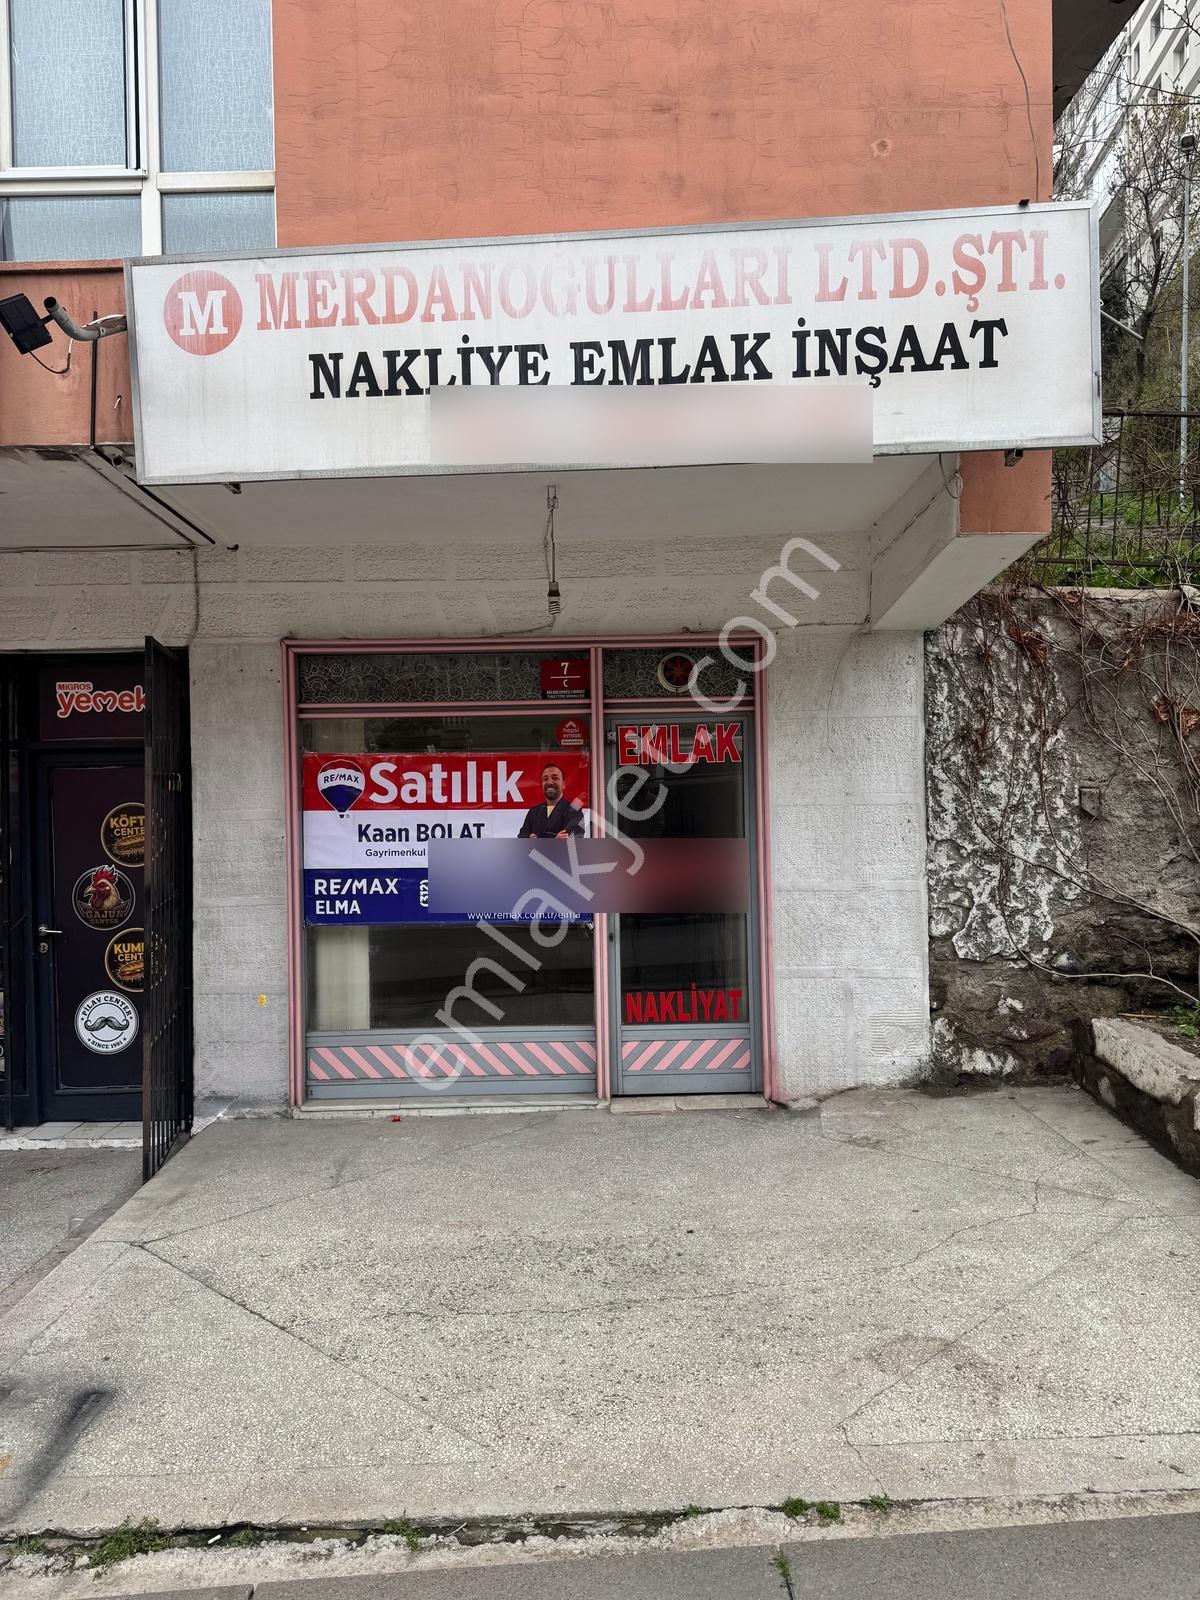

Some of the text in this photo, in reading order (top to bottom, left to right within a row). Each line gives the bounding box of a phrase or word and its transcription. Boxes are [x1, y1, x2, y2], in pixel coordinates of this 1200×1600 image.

[177, 290, 229, 337] M
[309, 317, 1008, 400] NAKLİYE EMLAK İNŞAAT
[560, 662, 570, 676] 7
[617, 723, 742, 765] EMLAK
[323, 774, 360, 784] RE/MAX
[369, 761, 525, 804] Satılık
[110, 814, 145, 829] KÖFT
[113, 826, 145, 837] CENTE
[357, 823, 410, 843] Kaan
[365, 848, 426, 859] Gayrimenkul
[314, 878, 399, 896] RE/MAX
[315, 900, 361, 915] ELMA
[117, 952, 144, 962] CENT
[103, 995, 132, 1017] CENTER
[626, 982, 744, 1024] NAKLİYAT
